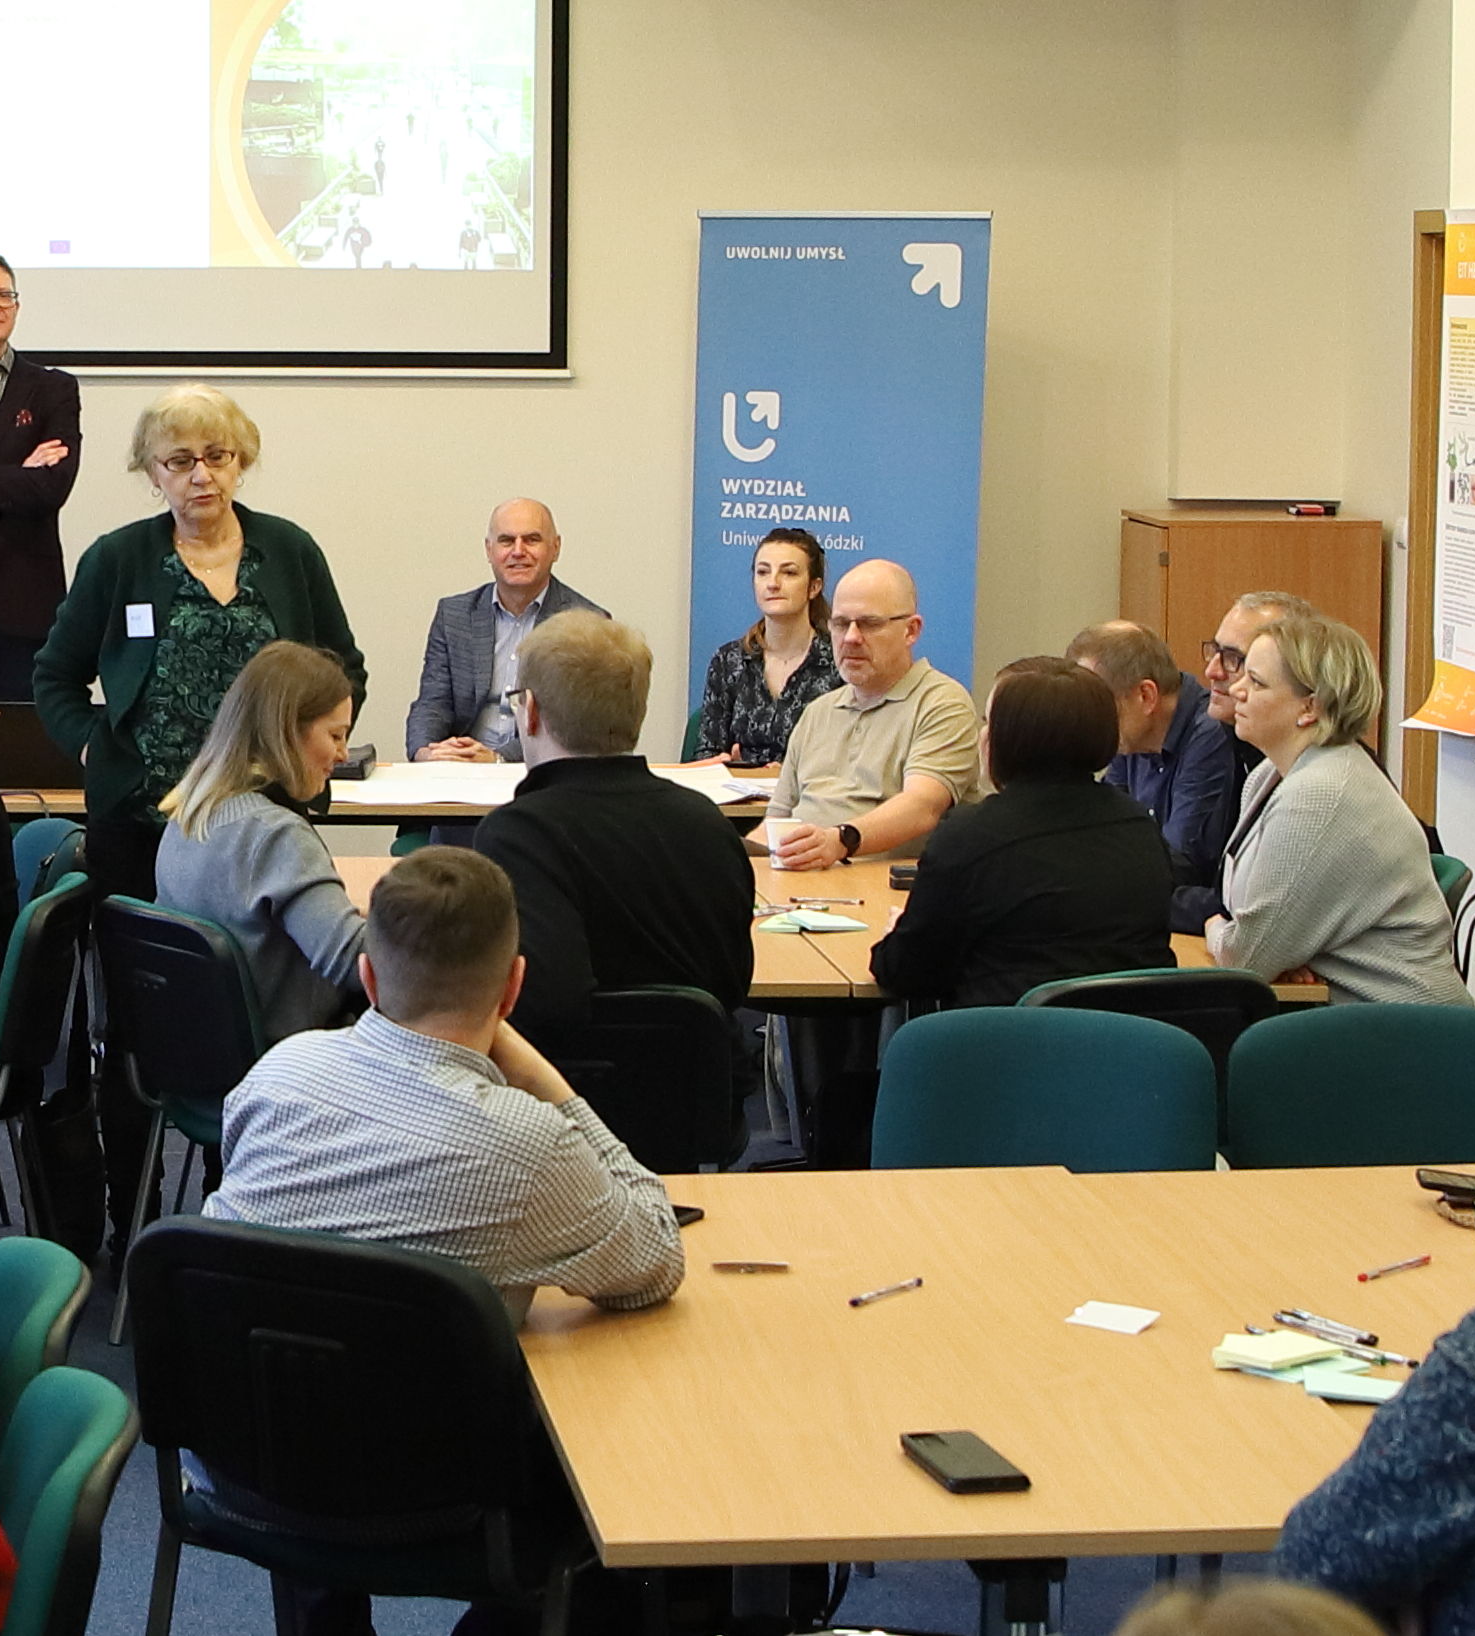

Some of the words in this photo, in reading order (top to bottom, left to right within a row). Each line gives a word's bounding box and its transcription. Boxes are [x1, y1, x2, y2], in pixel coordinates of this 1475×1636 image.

[726, 246, 793, 260] UWOLNIJ
[796, 246, 846, 260] UMYSŁ
[1458, 262, 1468, 279] EIT
[721, 478, 807, 497] WYDZIAŁ
[720, 501, 851, 524] ZARZĄDZANIA
[816, 532, 865, 552] Łódzki
